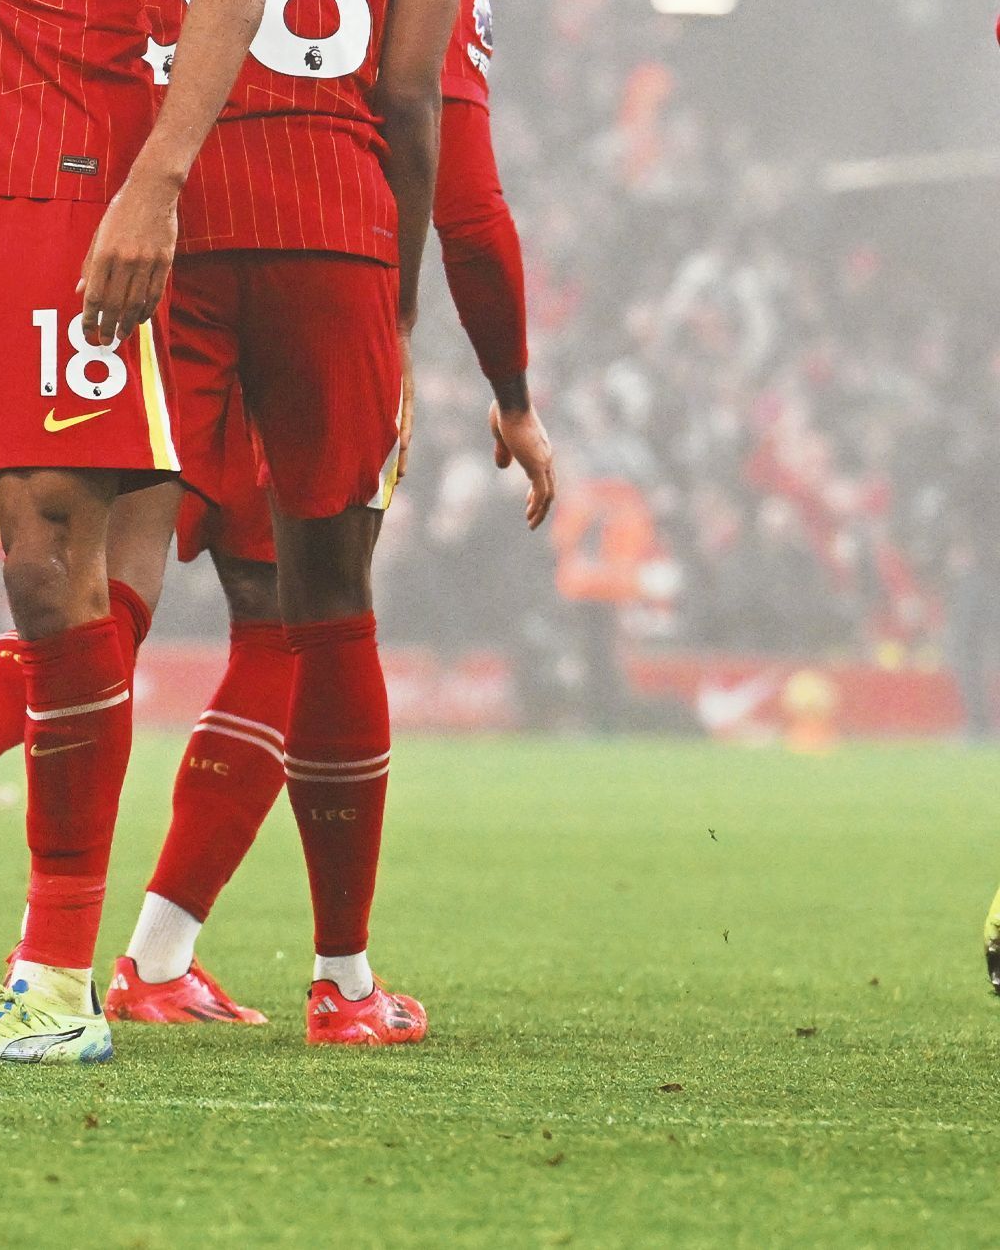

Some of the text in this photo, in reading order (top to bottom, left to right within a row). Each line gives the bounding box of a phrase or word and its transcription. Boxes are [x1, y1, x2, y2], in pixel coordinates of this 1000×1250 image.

[32, 308, 128, 401] 18
[190, 757, 229, 776] LFC
[311, 808, 356, 821] LFC
